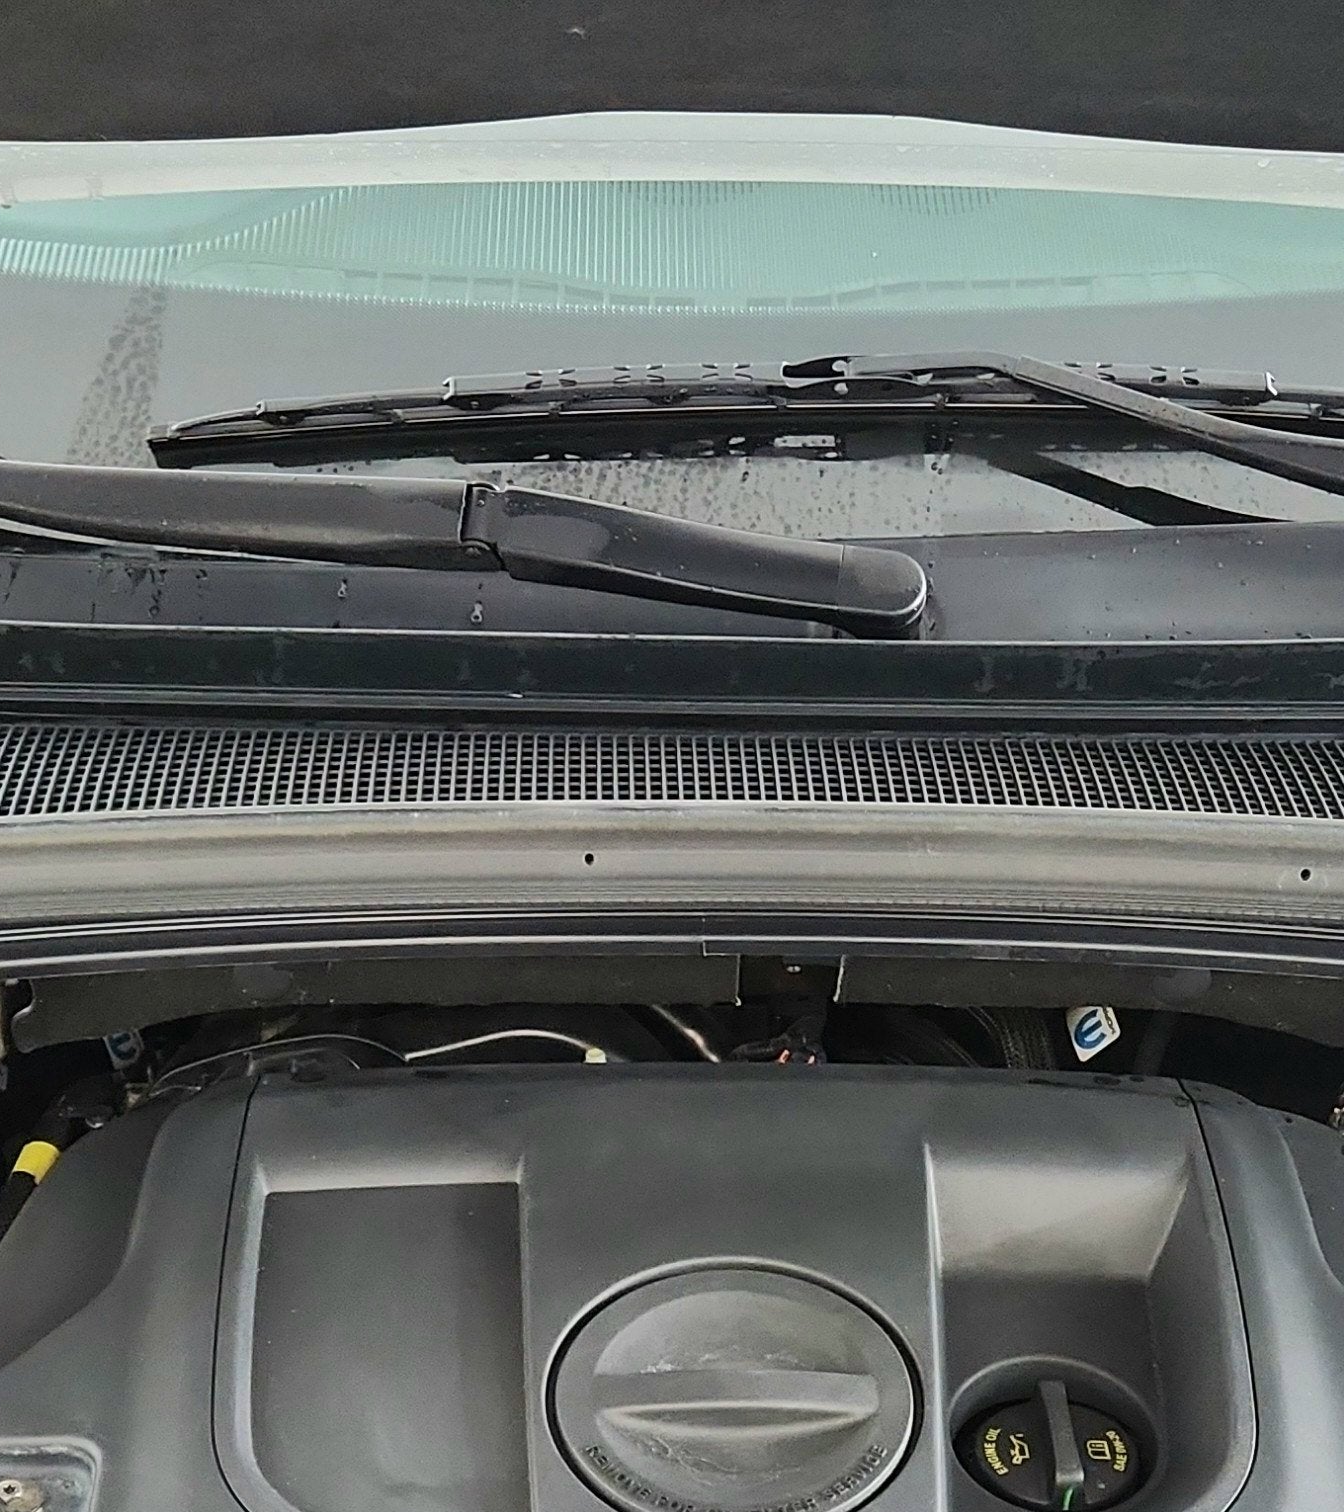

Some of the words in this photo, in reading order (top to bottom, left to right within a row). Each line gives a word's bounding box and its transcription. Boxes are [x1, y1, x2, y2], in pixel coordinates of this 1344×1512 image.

[985, 1428, 1001, 1441] OIL
[585, 1445, 652, 1499] REMOVE
[821, 1444, 888, 1503] SERVICE
[983, 1442, 1009, 1475] ENGINE
